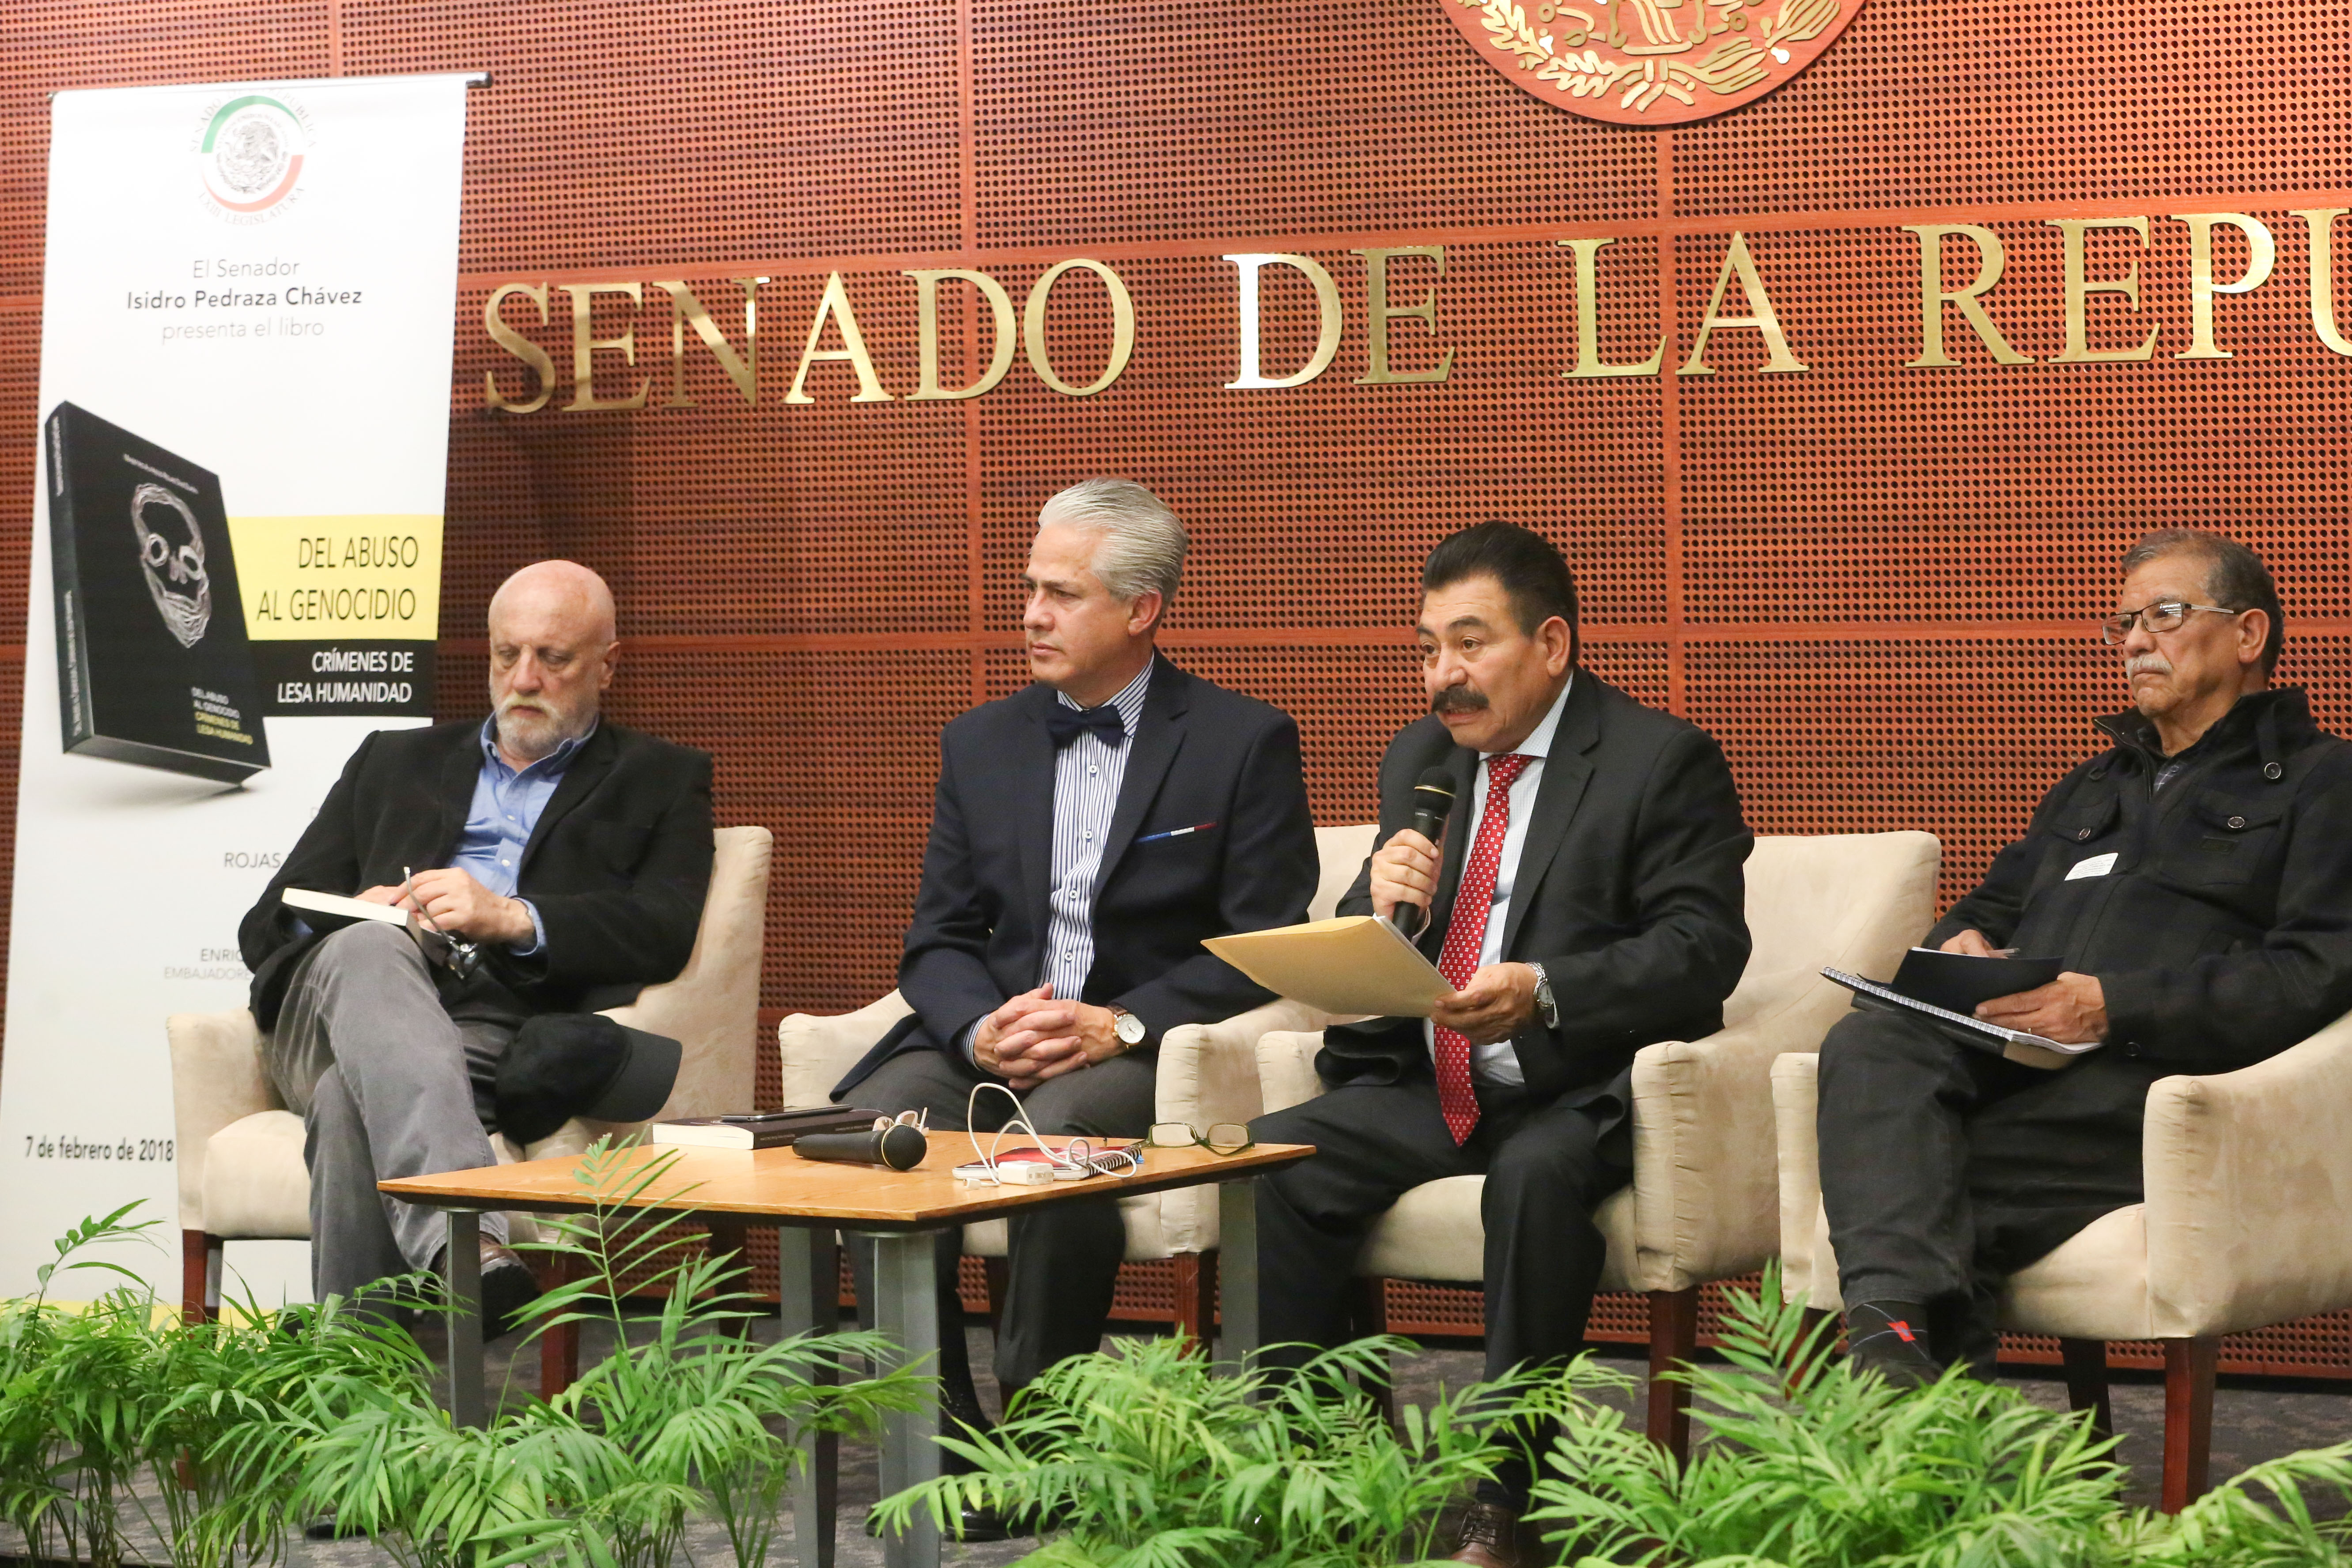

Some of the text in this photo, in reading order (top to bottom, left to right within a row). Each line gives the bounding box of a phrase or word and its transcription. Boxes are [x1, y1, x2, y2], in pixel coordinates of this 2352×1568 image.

[193, 257, 300, 278] El Senador
[128, 286, 362, 309] Isidro Pedraza Chávez
[162, 316, 324, 346] presenta el libro
[484, 258, 1135, 414] SENADO
[1222, 246, 1455, 389] DE
[1558, 230, 1809, 378] LA
[299, 536, 418, 568] DEL ABUSO
[257, 588, 416, 621] AL GENOCIDIO
[312, 647, 414, 673] CRÍMENES DE
[277, 682, 412, 703] LESA HUMANIDAD
[224, 852, 281, 869] ROJAS
[26, 1135, 174, 1161] 7 de febrero de 2018
